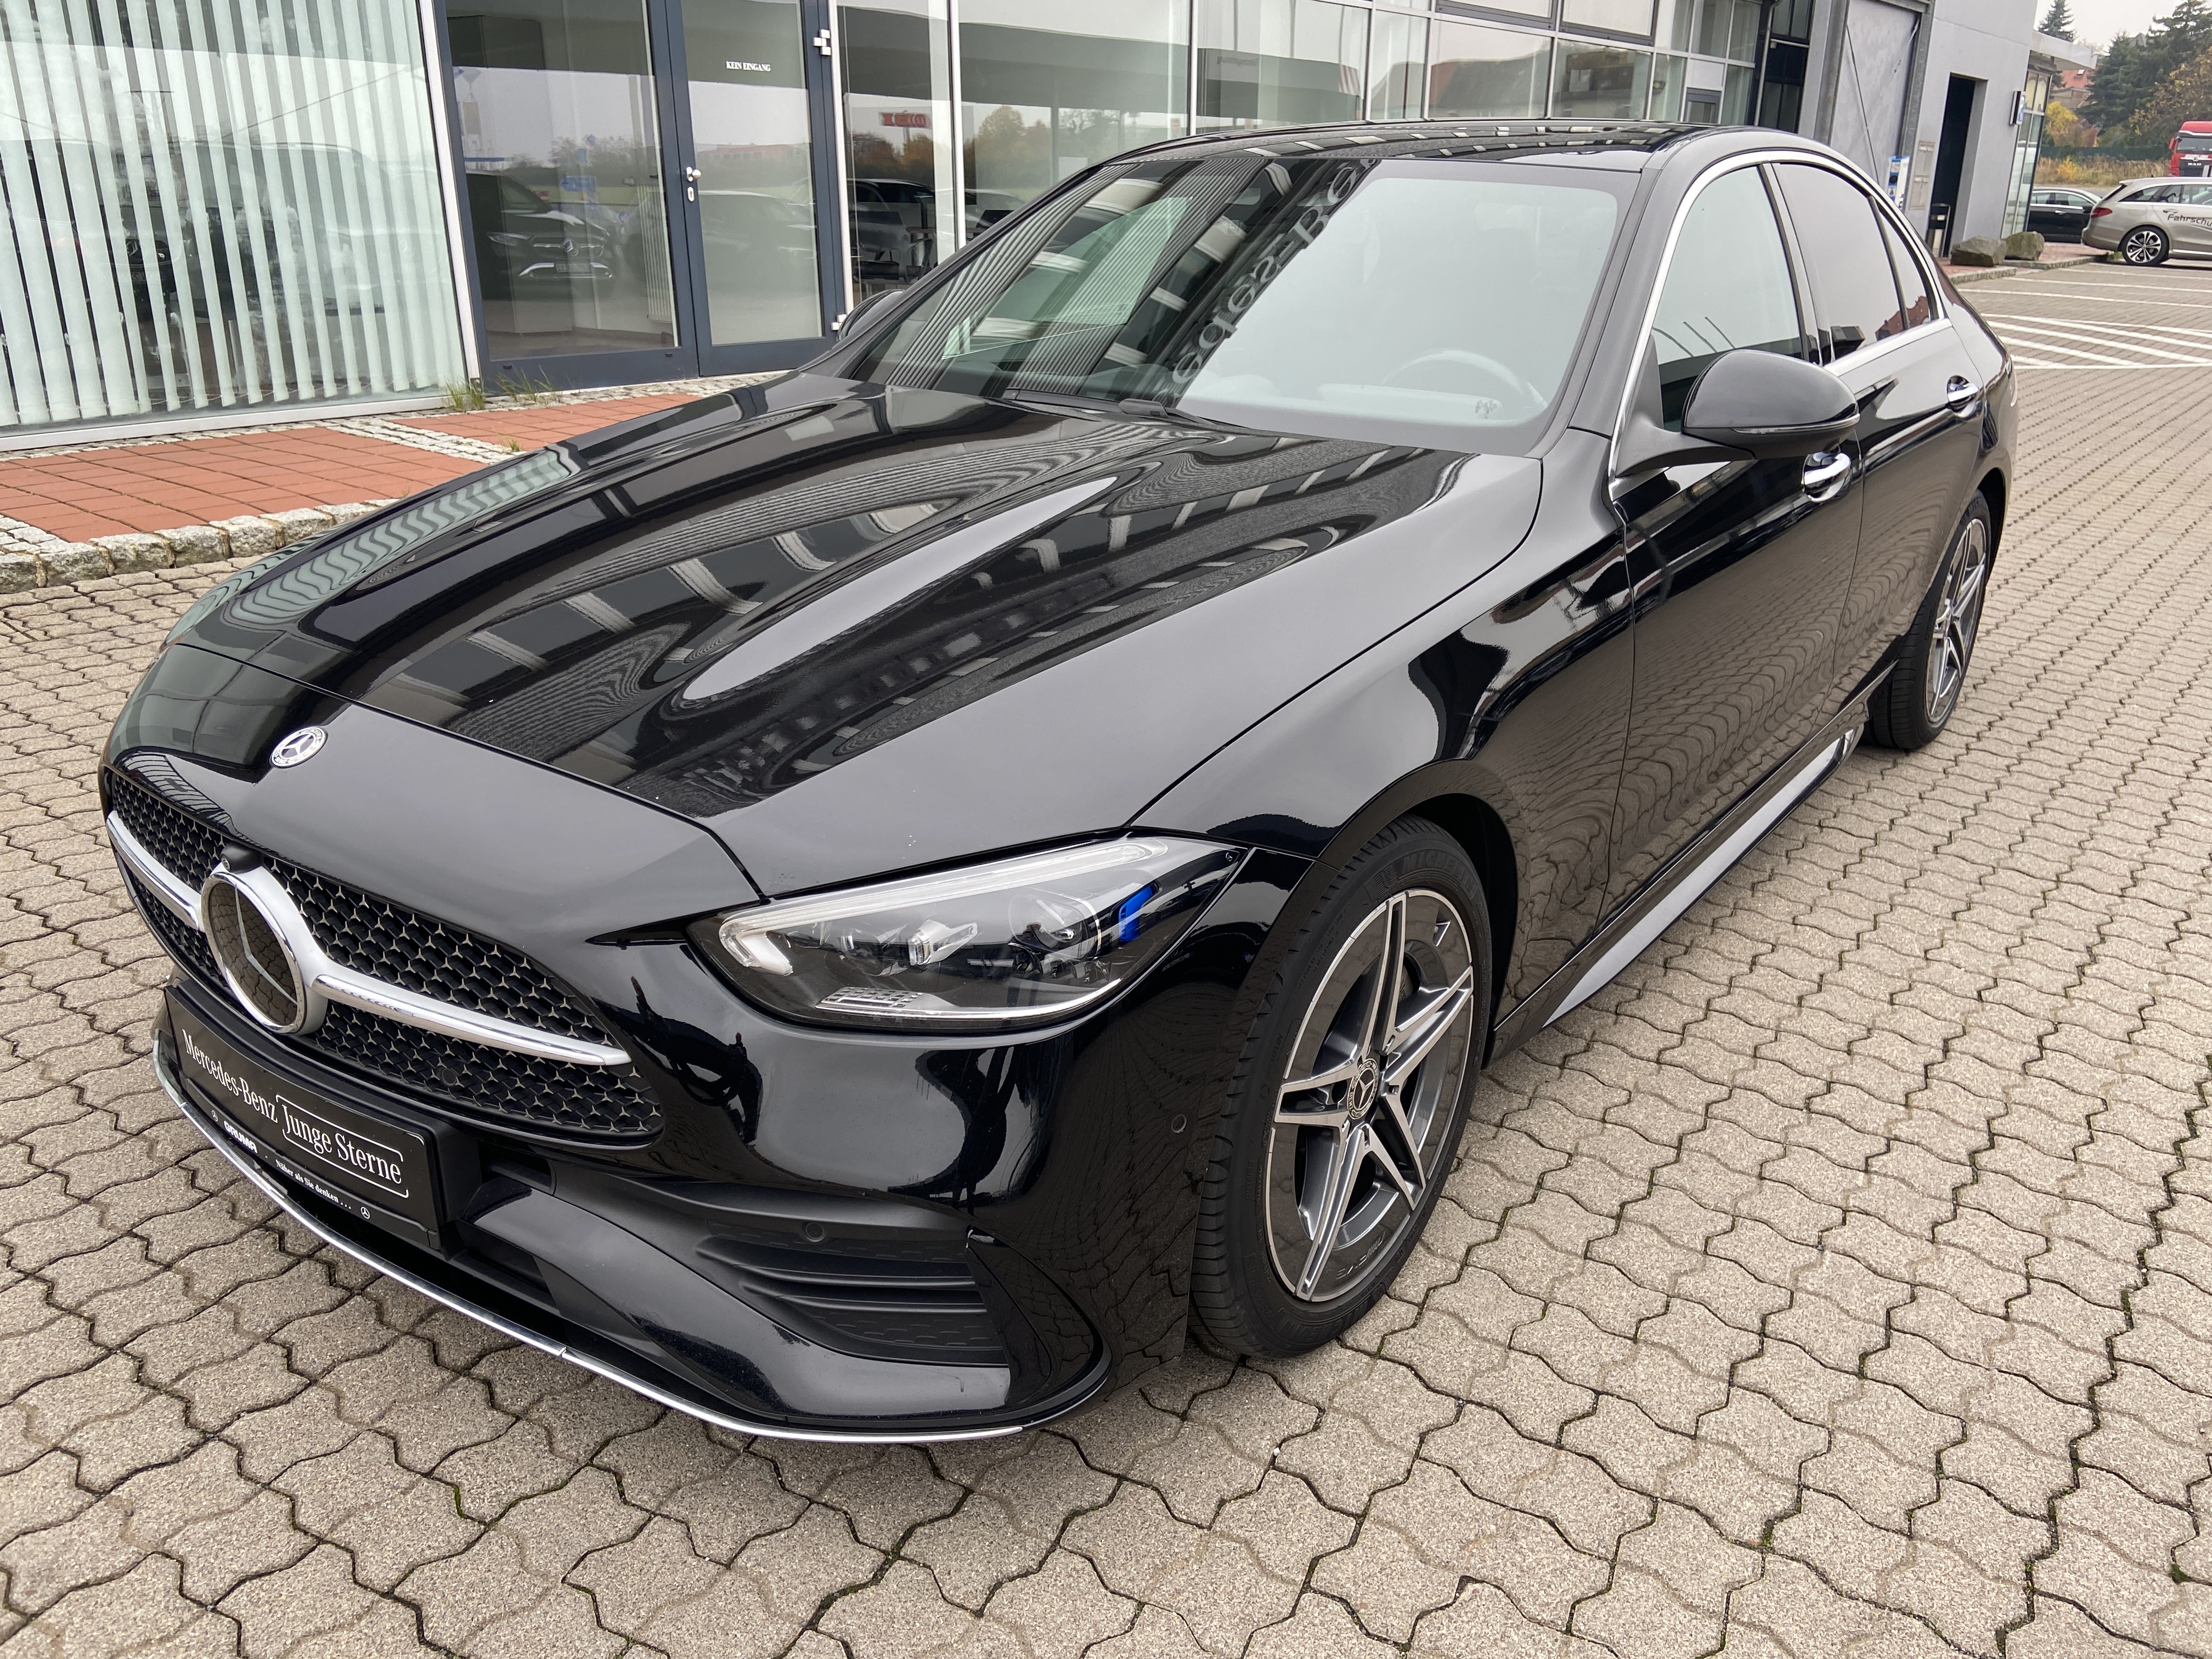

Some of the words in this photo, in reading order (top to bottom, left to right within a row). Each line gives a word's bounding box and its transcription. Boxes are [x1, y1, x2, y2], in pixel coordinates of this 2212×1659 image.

[726, 61, 742, 69] KEIN
[743, 63, 771, 71] EINGANG
[2168, 213, 2212, 227] Fahrschu
[1402, 851, 1477, 896] MICHELIN
[182, 1029, 278, 1123] Mercedes-Benz
[283, 1104, 332, 1154] Junge
[337, 1133, 402, 1184] Sterne
[224, 1120, 258, 1153] GRUMA
[275, 1159, 294, 1177] Näher
[295, 1173, 304, 1184] als
[304, 1177, 315, 1188] Sie
[315, 1183, 339, 1204] denken
